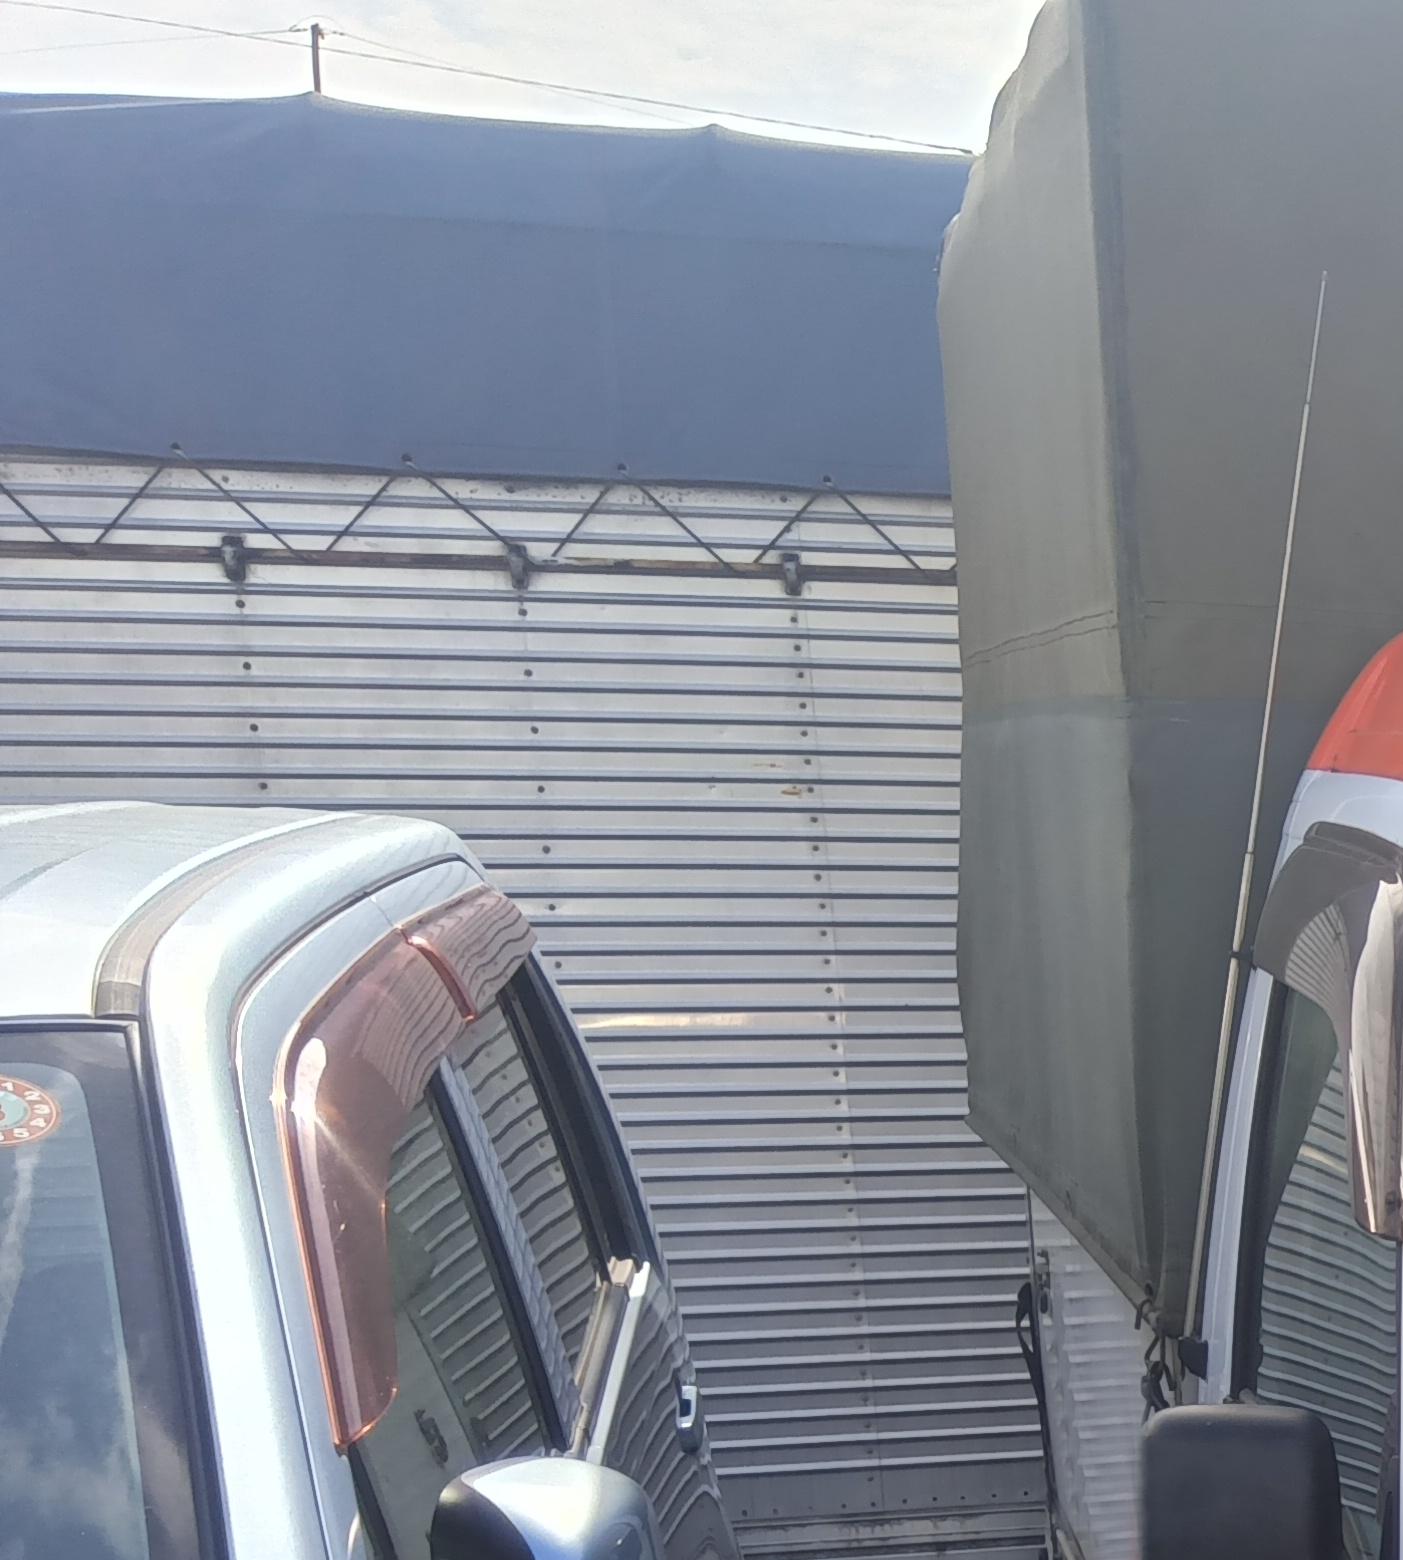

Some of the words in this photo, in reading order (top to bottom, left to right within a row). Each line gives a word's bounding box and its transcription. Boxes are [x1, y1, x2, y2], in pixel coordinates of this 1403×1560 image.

[24, 1090, 41, 1101] 2
[33, 1103, 51, 1115] 3
[30, 1117, 47, 1128] 4
[13, 1127, 30, 1138] 5
